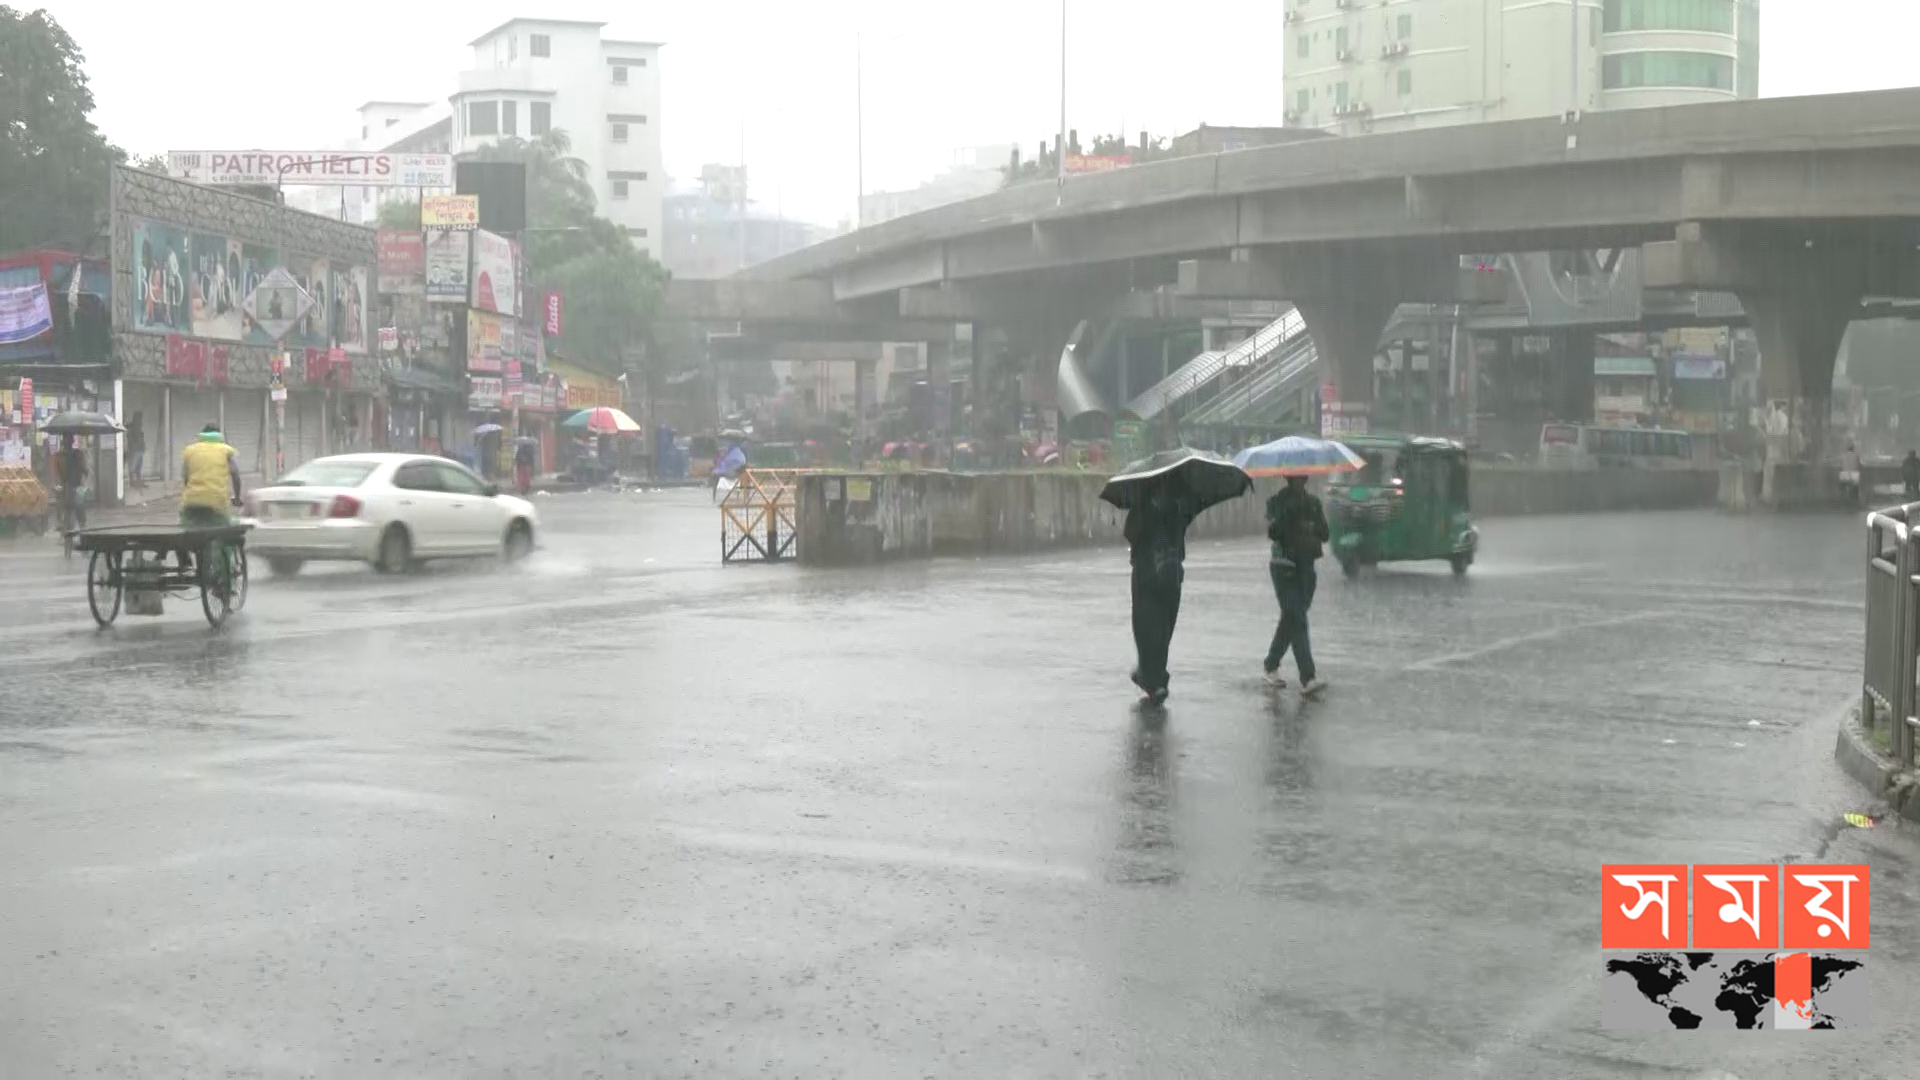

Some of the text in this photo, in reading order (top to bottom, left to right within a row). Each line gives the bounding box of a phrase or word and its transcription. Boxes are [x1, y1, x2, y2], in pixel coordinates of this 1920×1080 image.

[211, 154, 391, 175] PATRON IELTS
[546, 295, 559, 335] Bata
